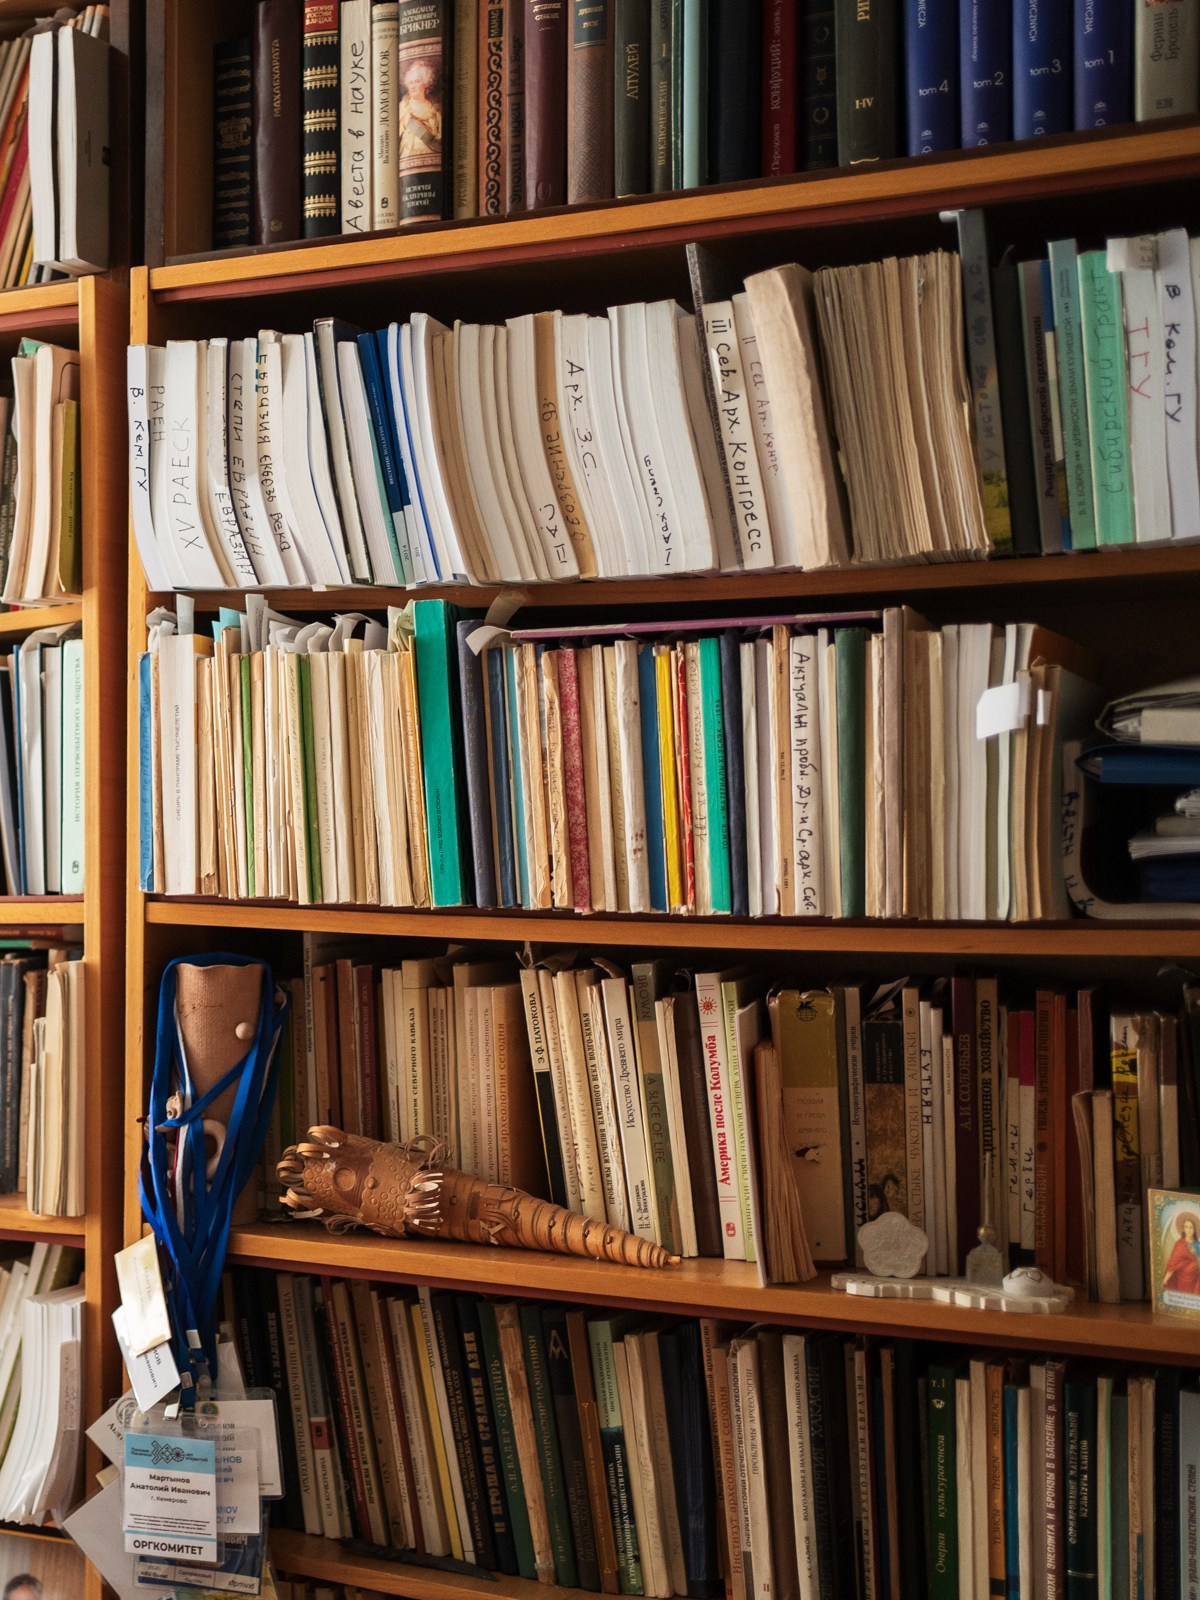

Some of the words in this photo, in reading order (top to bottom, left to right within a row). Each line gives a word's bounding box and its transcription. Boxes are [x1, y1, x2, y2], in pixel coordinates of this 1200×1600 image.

[400, 19, 440, 35] БРИКНЕР
[1150, 13, 1164, 62] Фернан
[1164, 8, 1179, 60] Бродель
[273, 39, 281, 117] МАХАБХАРАТА
[626, 42, 639, 100] АПУЛЕЙ
[974, 80, 992, 89] tom
[994, 71, 1004, 86] 2
[1030, 67, 1049, 76] tom
[1051, 59, 1061, 73] 3
[1085, 58, 1104, 69] tom
[1108, 50, 1115, 64] 1
[379, 50, 390, 127] ЛОМОНОСОВ
[919, 87, 937, 97] tom
[939, 80, 949, 92] 4
[349, 128, 364, 138] в
[1033, 316, 1046, 383] археологии
[1063, 317, 1075, 366] КУЗНЕЦКОЙ
[1067, 368, 1078, 397] ЗЕМЛИ
[1037, 387, 1051, 448] сибирской
[1069, 399, 1081, 447] ДРЕВНОСТИ
[378, 425, 389, 455] BULLETIN
[1043, 452, 1056, 497] Рыцарь
[1074, 463, 1084, 497] БОБРОВ
[175, 518, 204, 550] XV
[401, 544, 410, 561] 2014
[74, 657, 82, 705] ОБЩЕСТВА
[73, 707, 81, 777] ПЕРВОБЫТНОГО
[528, 992, 541, 1044] ПАТОКОВА
[637, 974, 656, 1019] BROWN
[582, 1012, 596, 1061] ВОЛГО-КАМЬЯ
[613, 1018, 624, 1041] мира
[848, 1026, 858, 1051] очерки
[590, 1063, 599, 1081] ВЕКА
[618, 1043, 630, 1083] Древнего
[705, 1034, 721, 1091] Колумба
[906, 1031, 917, 1081] АЛЯСКИ
[958, 1034, 971, 1102] СОЛОВЬЕВ
[647, 1077, 661, 1085] A
[850, 1054, 861, 1126] Историографические
[593, 1084, 604, 1125] КАМЕННОГО
[624, 1084, 636, 1128] Искусство
[648, 1090, 665, 1120] SLICE
[710, 1093, 725, 1128] после
[961, 1117, 972, 1131] А.
[599, 1128, 610, 1163] ИЗУЧЕНИЯ
[651, 1122, 666, 1140] OF
[907, 1104, 920, 1160] ЧУКОТКИ
[653, 1143, 667, 1164] LIFE
[714, 1132, 731, 1186] Америка
[604, 1166, 615, 1205] ПРОБЛЕМЫ
[909, 1167, 922, 1206] СТЫКЕ
[910, 1210, 922, 1227] НА
[283, 1292, 297, 1346] НОВГОРОДА
[527, 1334, 545, 1400] ПАМЯТНИКИ
[702, 1325, 714, 1372] археологии
[289, 1349, 302, 1401] ИЗУЧЕНИЕ
[730, 1362, 742, 1413] АРХЕОЛОГИИ
[745, 1368, 756, 1424] АРХЕОЛОГИИ
[1045, 1371, 1055, 1400] ВЯТКИ
[707, 1374, 718, 1433] отечественной
[718, 1386, 732, 1435] сегодня
[807, 1366, 824, 1437] ХАКАСИИ
[855, 1375, 866, 1430] ЕВРАЗИИ
[991, 1390, 1000, 1439] ABSTRACTS
[294, 1404, 311, 1495] АРХЕОЛОГИЧЕСКОЕ
[711, 1434, 720, 1466] истории
[734, 1414, 747, 1478] ОТЕЧЕСТВЕННОЙ
[750, 1428, 760, 1475] ПРОБЛЕМЫ
[1044, 1415, 1055, 1458] БАССЕЙНЕ
[1067, 1412, 1078, 1476] МАТЕРИАЛЬНОЙ
[1079, 1440, 1088, 1470] ХАНТОВ
[149, 1474, 190, 1484] Мартынов
[614, 1444, 625, 1477] ЕВРАЗИИ
[722, 1438, 740, 1513] археологии
[935, 1435, 947, 1517] культурогенеза
[991, 1456, 1000, 1491] THESEN
[1186, 1464, 1196, 1492] степей
[130, 1483, 169, 1492] Анатолий
[171, 1487, 210, 1496] Иванович
[156, 1496, 187, 1504] Кемерово
[618, 1478, 628, 1514] ОБЩЕСТВ
[714, 1468, 725, 1500] Очерки
[739, 1479, 749, 1515] ИСТОРИИ
[1045, 1472, 1055, 1508] БРОНЗЫ
[1079, 1474, 1088, 1517] КУЛЬТУРЫ
[133, 1540, 203, 1556] ОРГКОМИТЕТ
[623, 1514, 636, 1578] ТРАДИЦИОННЫХ
[729, 1516, 742, 1575] Институт
[742, 1516, 751, 1547] ОЧЕРКИ
[992, 1509, 1001, 1544] ТЕЗИСЫ
[1045, 1524, 1056, 1569] ЭНЕОЛИТА
[935, 1533, 947, 1573] Очерки
